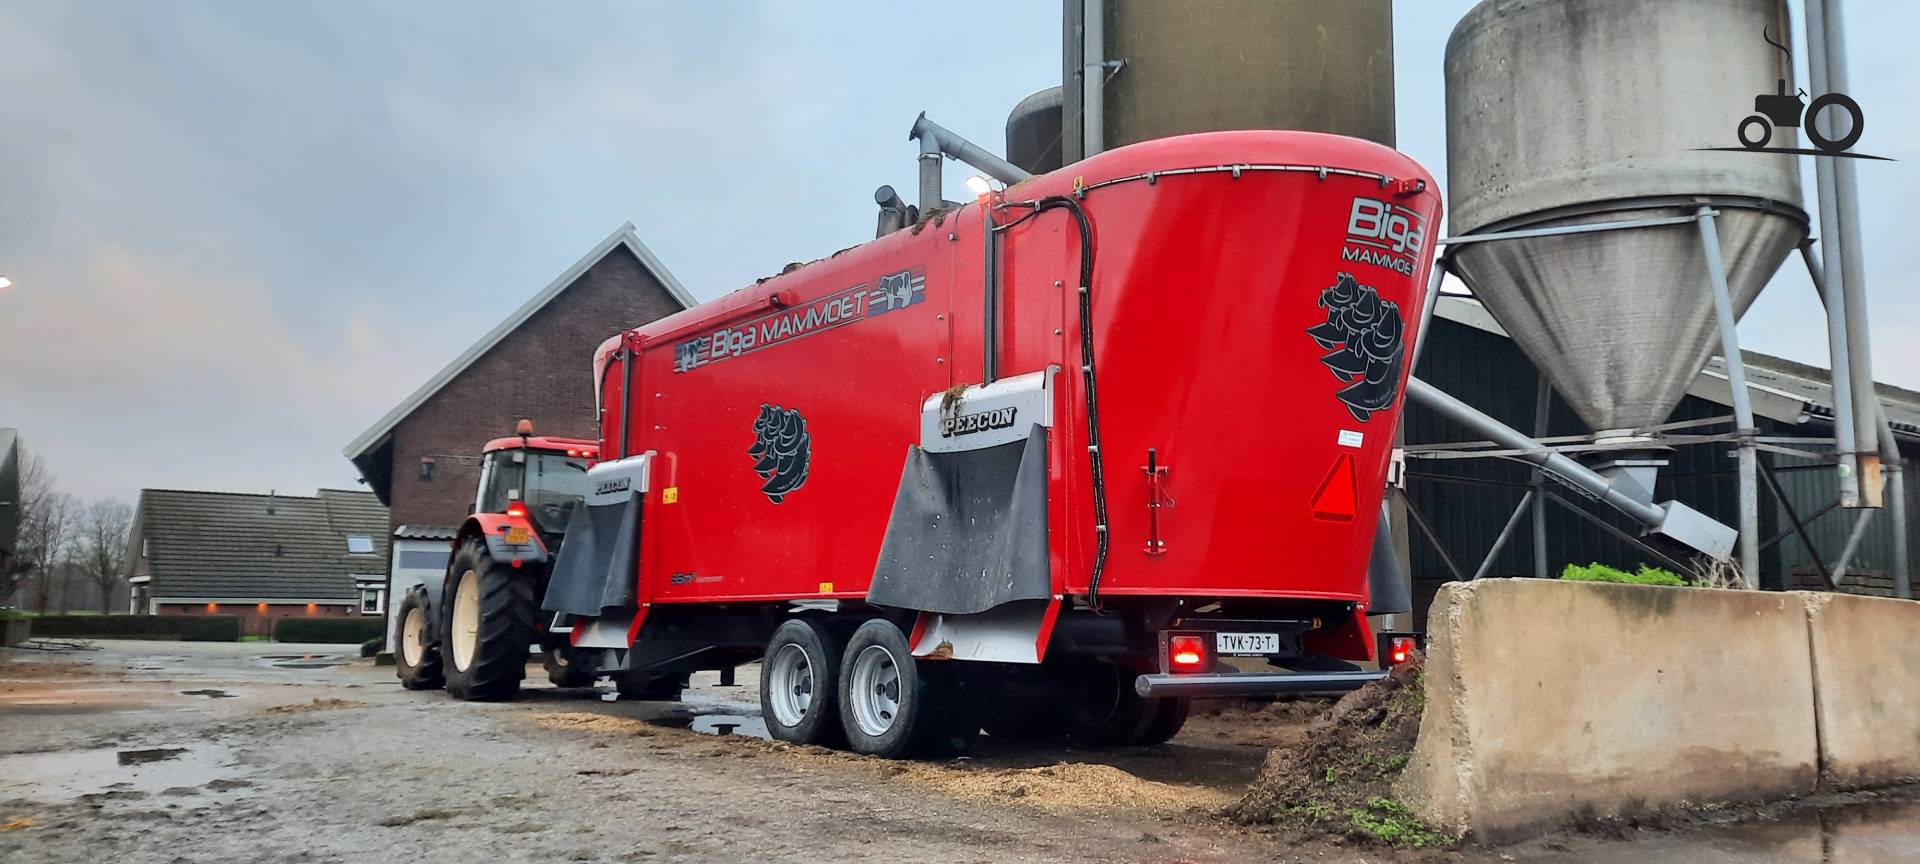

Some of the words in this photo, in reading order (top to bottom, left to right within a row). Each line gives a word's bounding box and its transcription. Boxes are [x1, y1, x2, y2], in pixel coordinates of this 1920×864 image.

[1347, 196, 1424, 253] Biga
[1342, 246, 1417, 277] MAMMOET
[711, 328, 757, 358] Biga
[760, 289, 867, 344] MAMMOET
[942, 407, 1017, 438] PEECON
